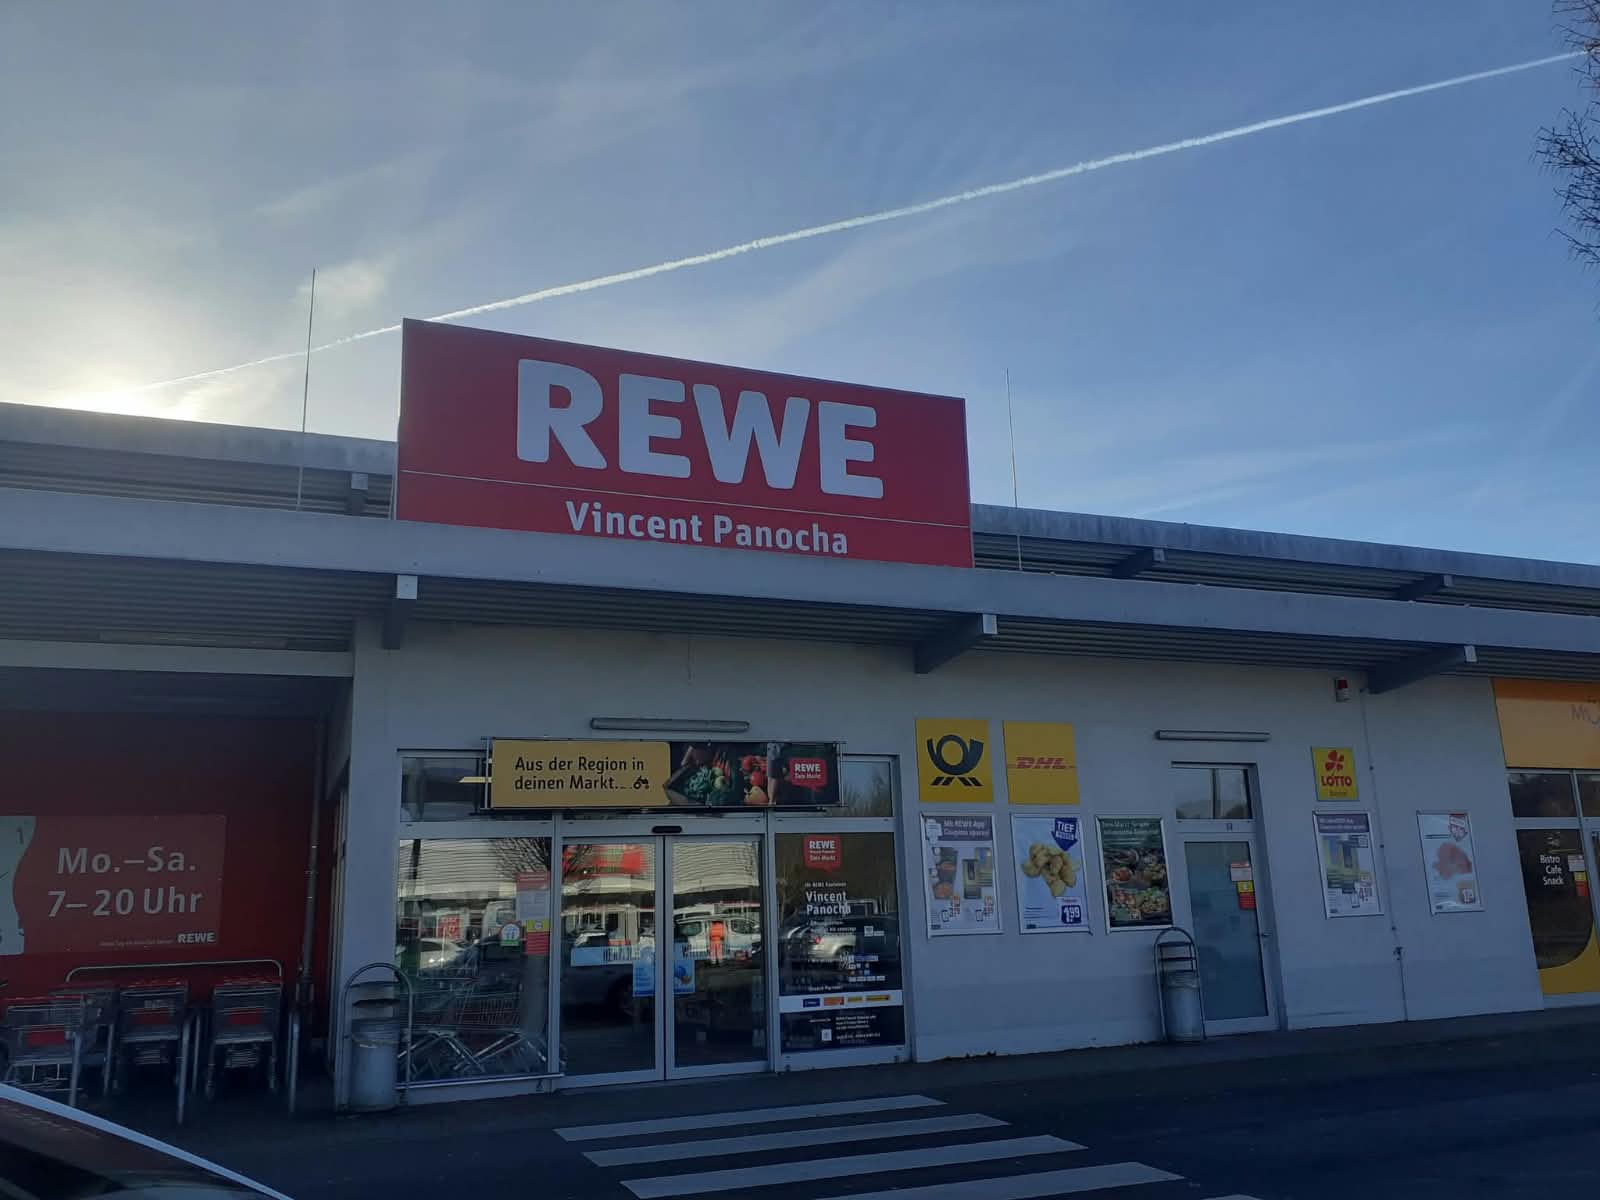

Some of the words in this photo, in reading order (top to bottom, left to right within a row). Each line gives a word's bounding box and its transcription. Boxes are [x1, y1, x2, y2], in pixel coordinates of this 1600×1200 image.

[516, 358, 884, 499] REWE
[565, 500, 703, 543] Vincent
[713, 513, 848, 556] Panocha
[515, 756, 542, 771] Aus
[548, 756, 573, 771] der
[578, 756, 627, 775] Region
[632, 756, 644, 771] in
[794, 763, 821, 772] REWE
[1015, 757, 1066, 769] DHL
[515, 775, 564, 790] deinen
[1320, 775, 1353, 787] LOTTO
[1056, 821, 1075, 833] TIEF
[809, 840, 836, 849] REWE
[1539, 854, 1561, 864] Bistro
[1542, 876, 1565, 886] Snack
[142, 886, 203, 915] Uhr
[805, 890, 847, 903] Vincent
[806, 902, 852, 916] Panocha
[176, 932, 216, 944] REWE
